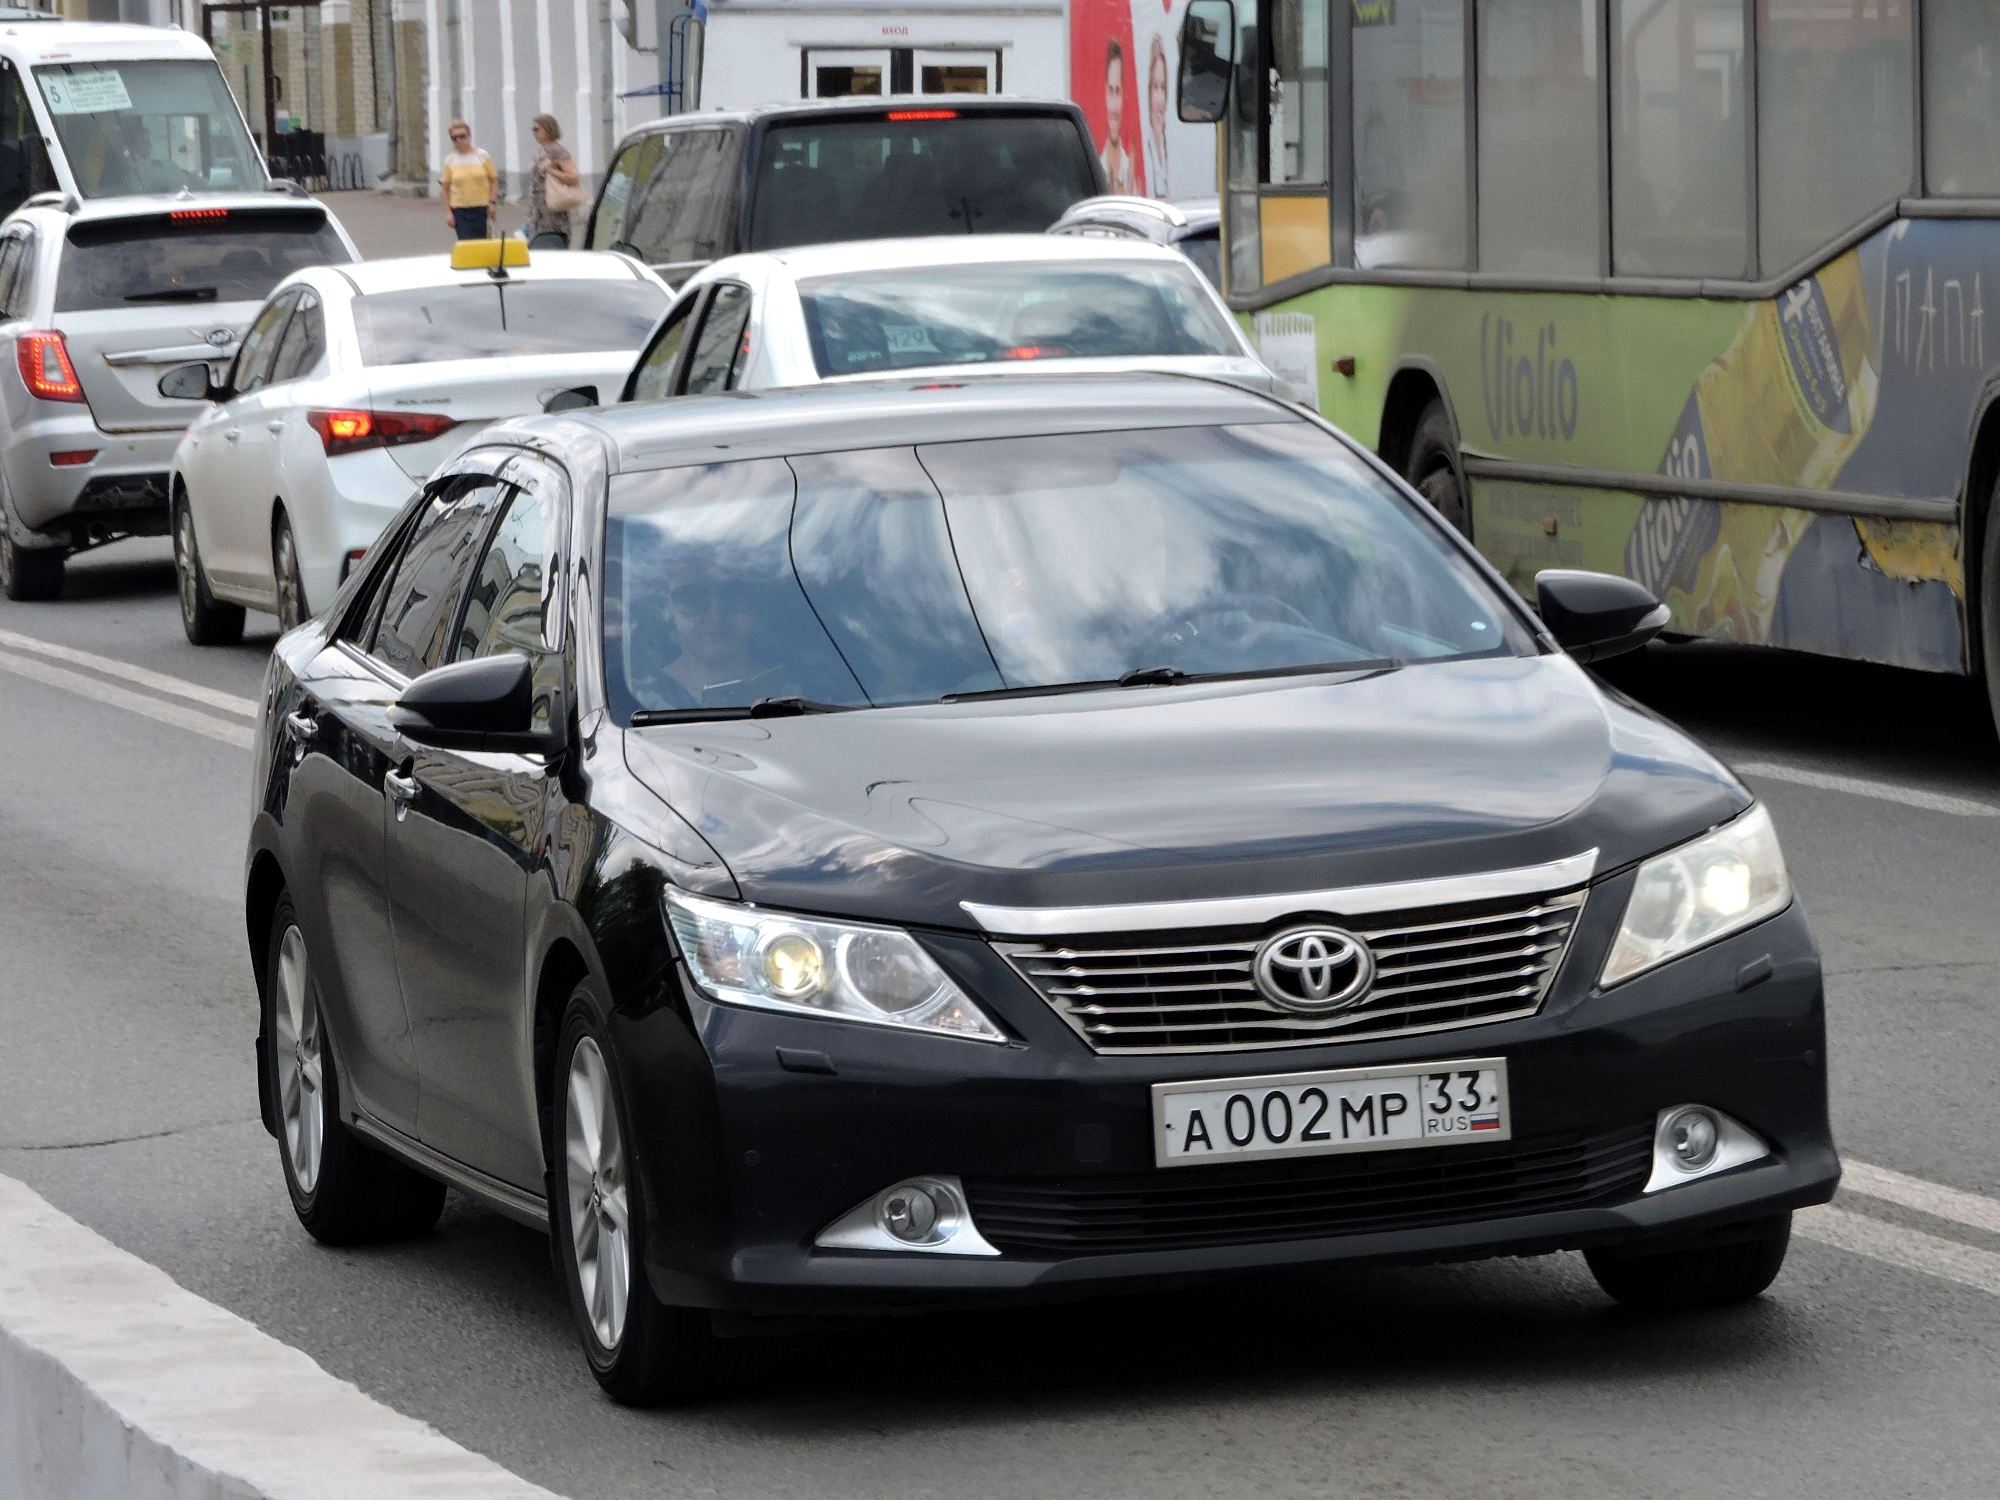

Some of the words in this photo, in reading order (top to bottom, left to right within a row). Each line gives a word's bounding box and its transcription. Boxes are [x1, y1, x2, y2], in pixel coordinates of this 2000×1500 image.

[881, 25, 908, 37] ВХОД
[1481, 312, 1578, 442] Violio
[1428, 1070, 1481, 1115] 33
[1427, 1115, 1469, 1133] RUS
